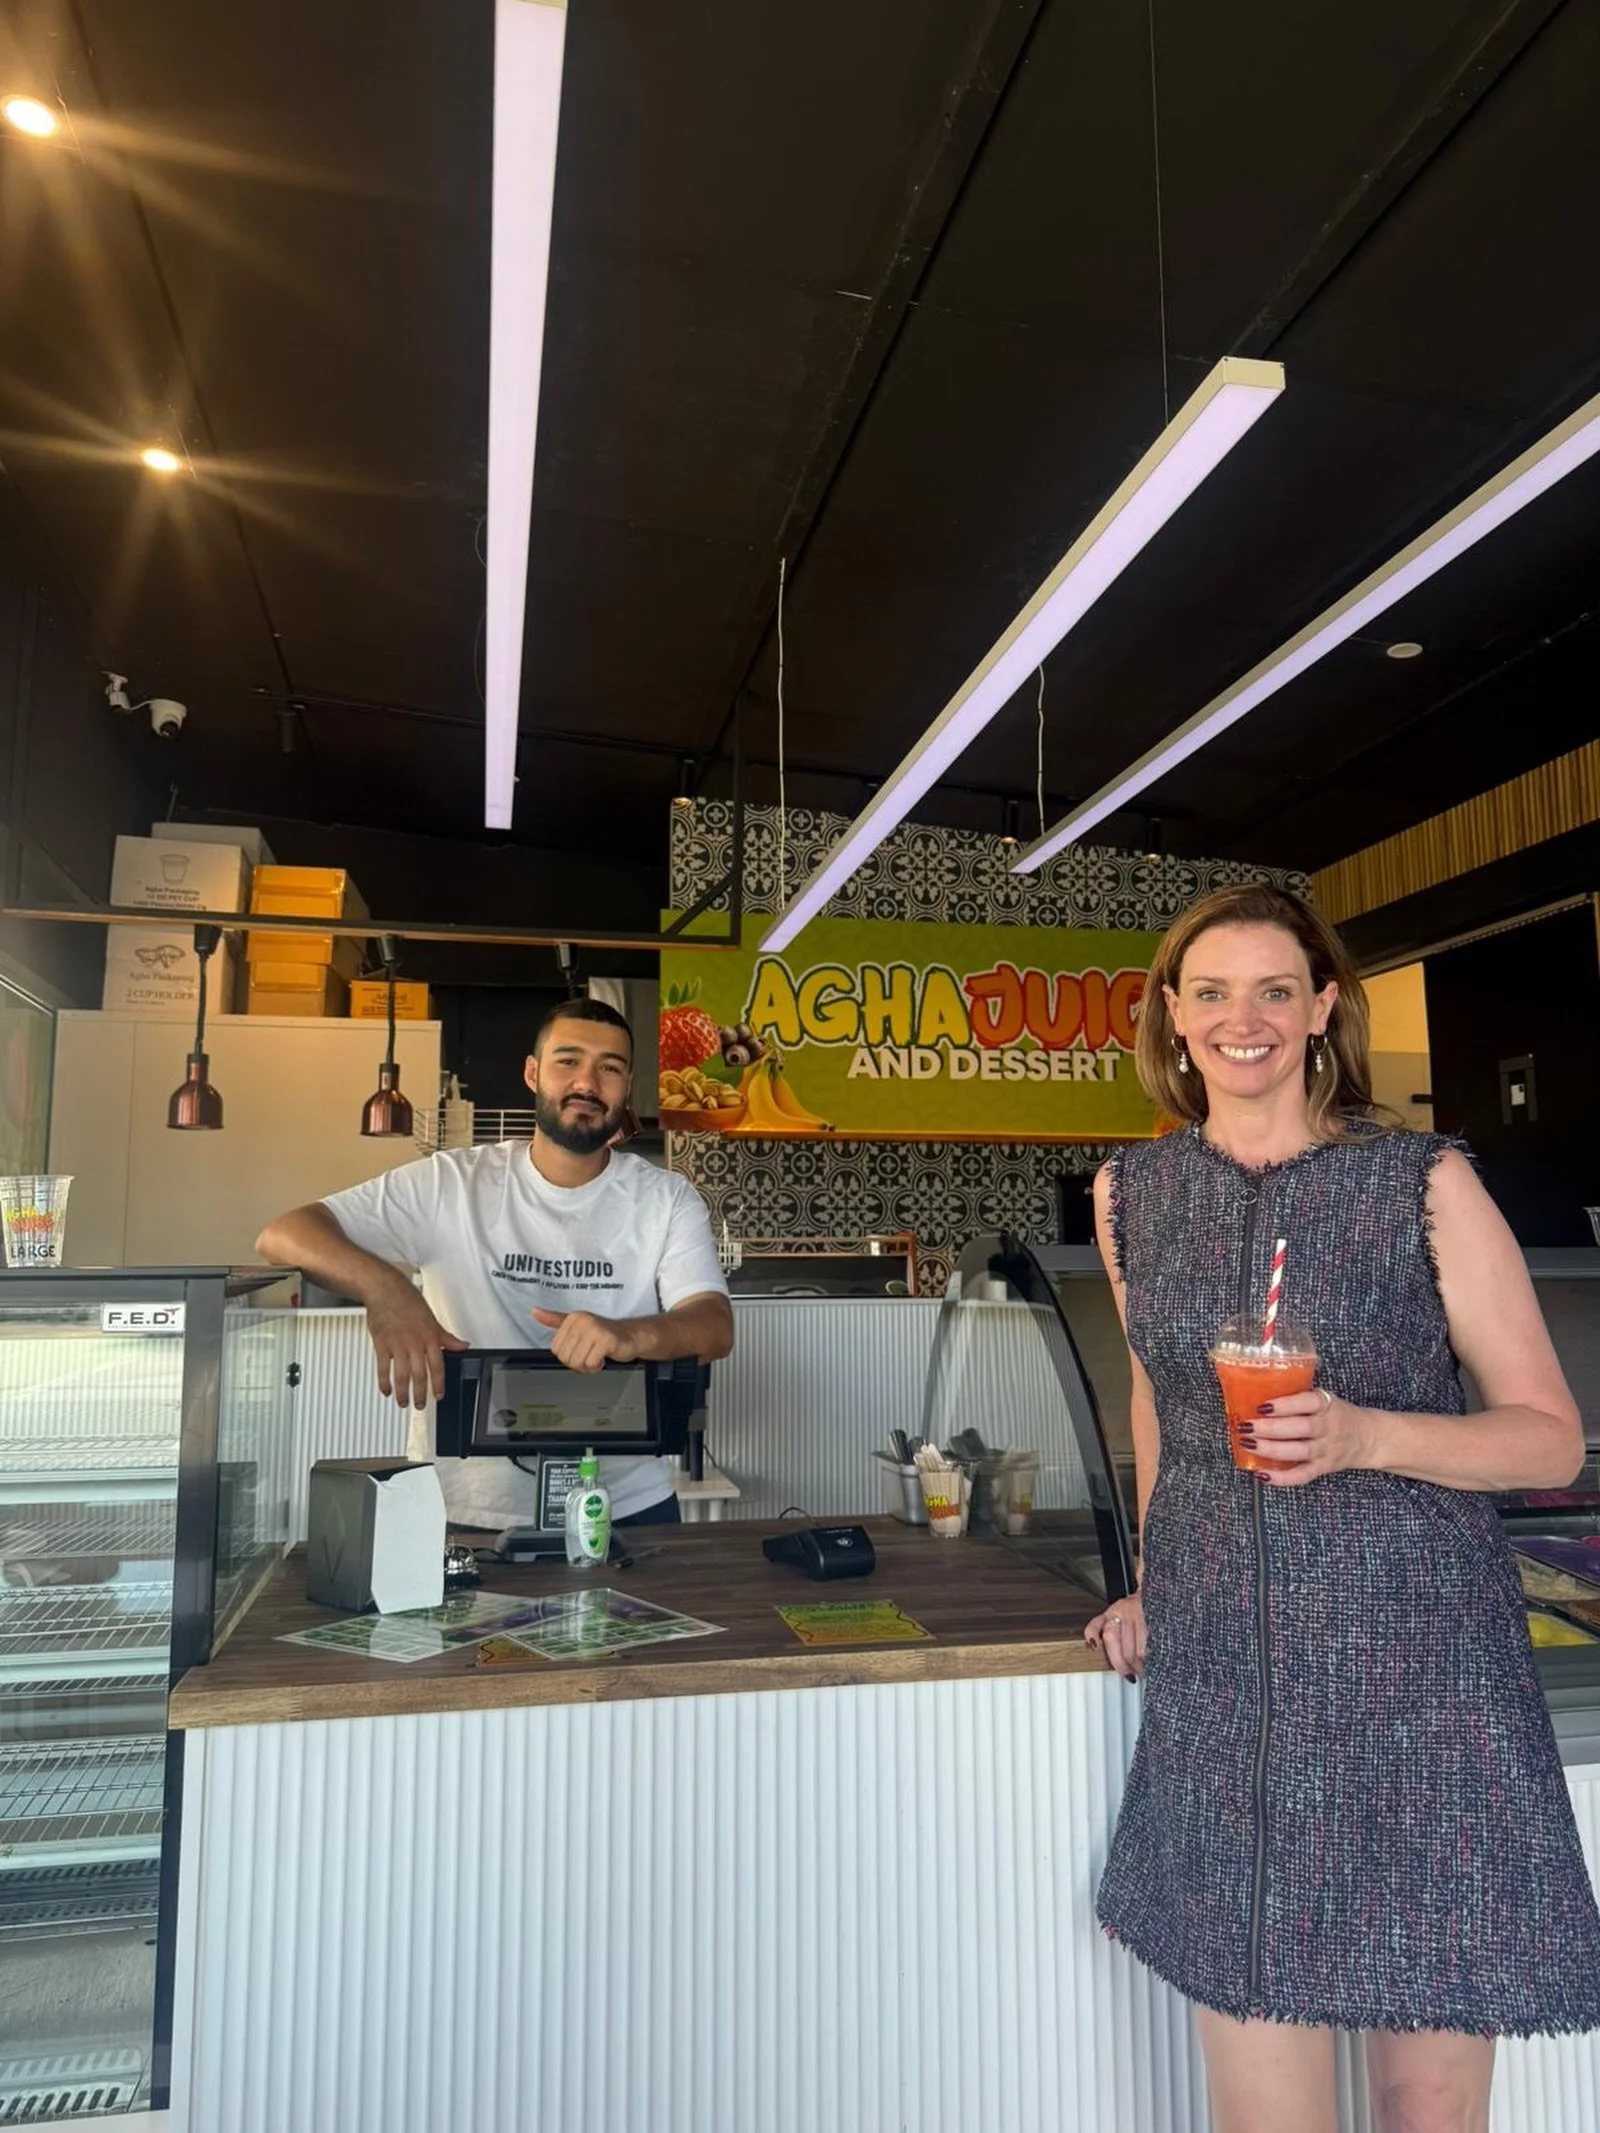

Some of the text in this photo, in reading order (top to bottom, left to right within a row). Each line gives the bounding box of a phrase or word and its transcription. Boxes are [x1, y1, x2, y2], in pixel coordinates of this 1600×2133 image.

[745, 955, 971, 1050] AGHA
[847, 1047, 1122, 1082] AND DESSERT
[11, 1244, 56, 1259] LARGE
[504, 1254, 613, 1277] UNITESTUDIO
[108, 1312, 175, 1325] F.E.D.
